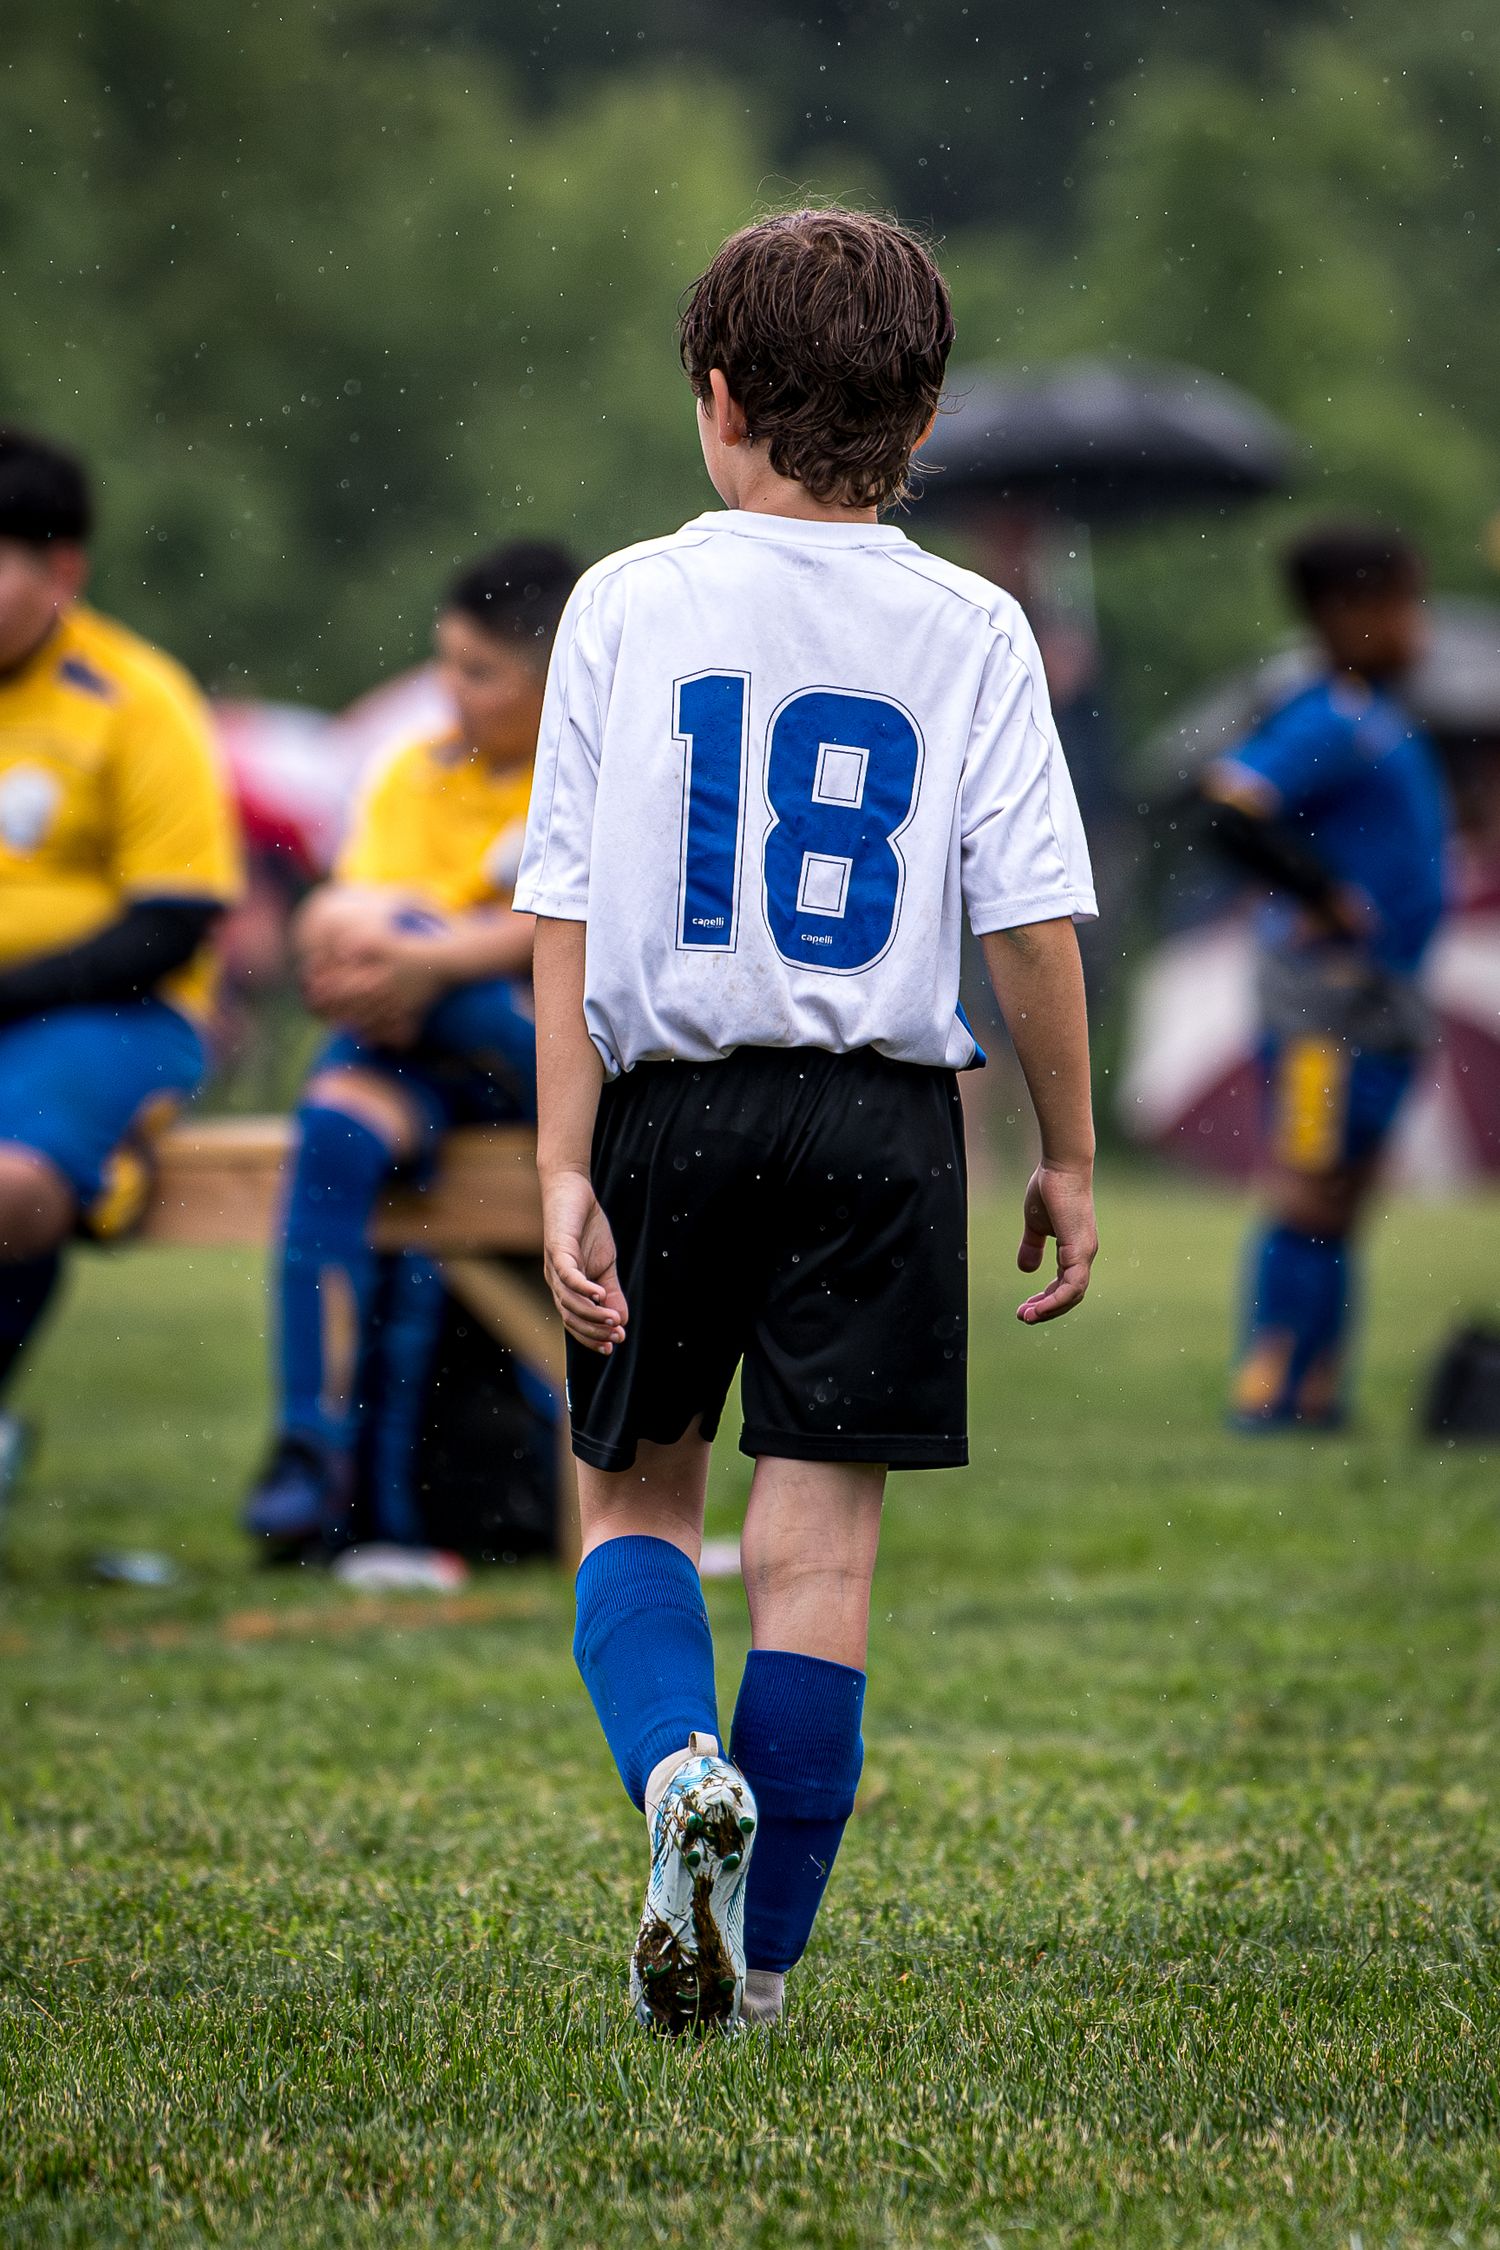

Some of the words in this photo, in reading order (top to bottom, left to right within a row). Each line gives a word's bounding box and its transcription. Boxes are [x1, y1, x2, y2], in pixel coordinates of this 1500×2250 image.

[672, 667, 924, 976] 18
[692, 917, 724, 927] capelli
[801, 934, 832, 944] capelli
